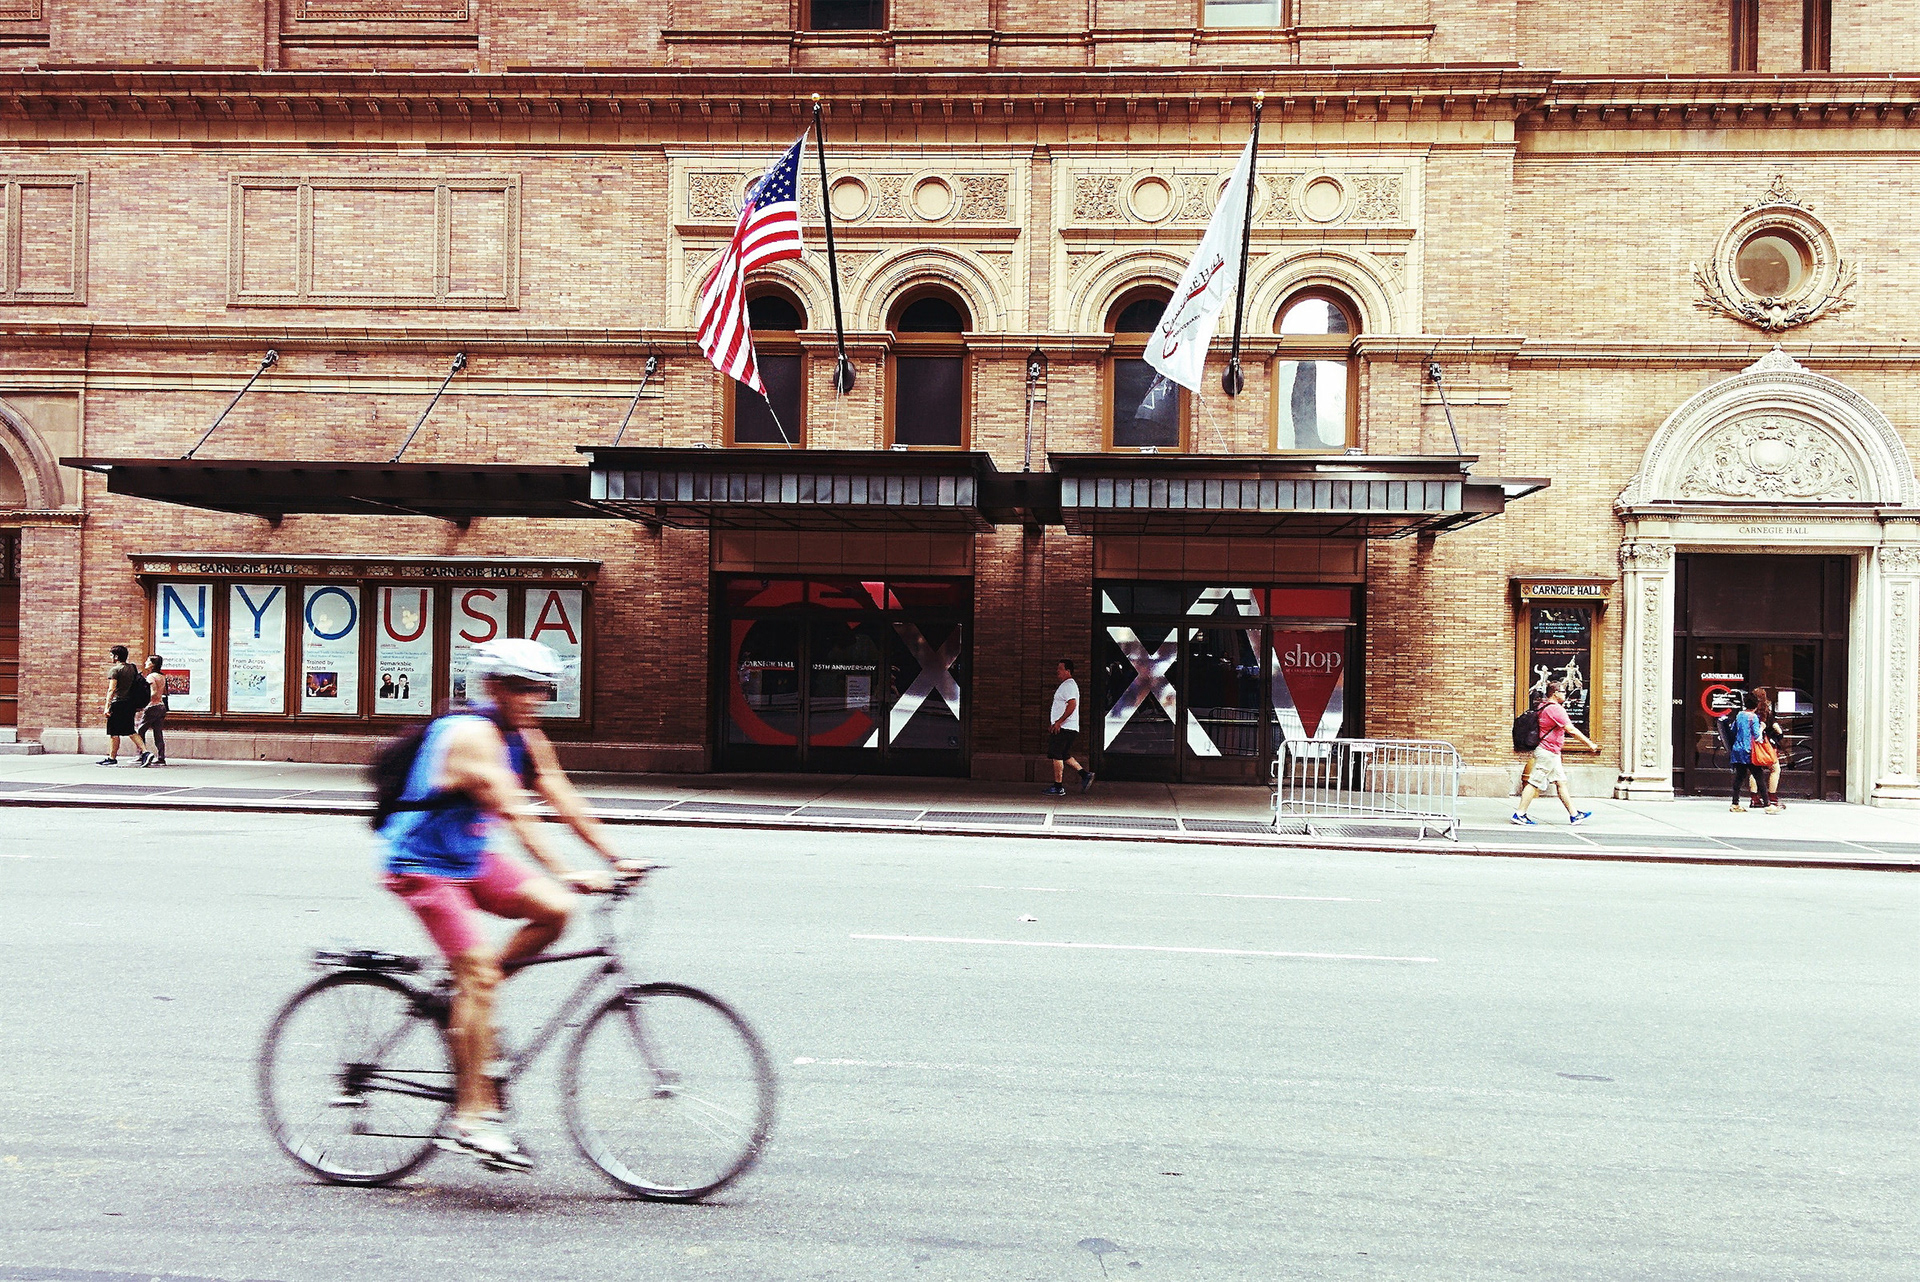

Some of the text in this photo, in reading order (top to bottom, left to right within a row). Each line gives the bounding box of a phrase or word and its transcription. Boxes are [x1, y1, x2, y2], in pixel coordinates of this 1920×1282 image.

[1738, 526, 1784, 534] CARNEGIE
[199, 563, 299, 574] CARNEGIE HALL
[423, 566, 525, 577] CARNEGIE HALL
[1532, 585, 1601, 595] CARNEGIE HALL
[327, 659, 335, 667] by
[1284, 643, 1342, 674] shop
[743, 660, 777, 668] CARNEGIE
